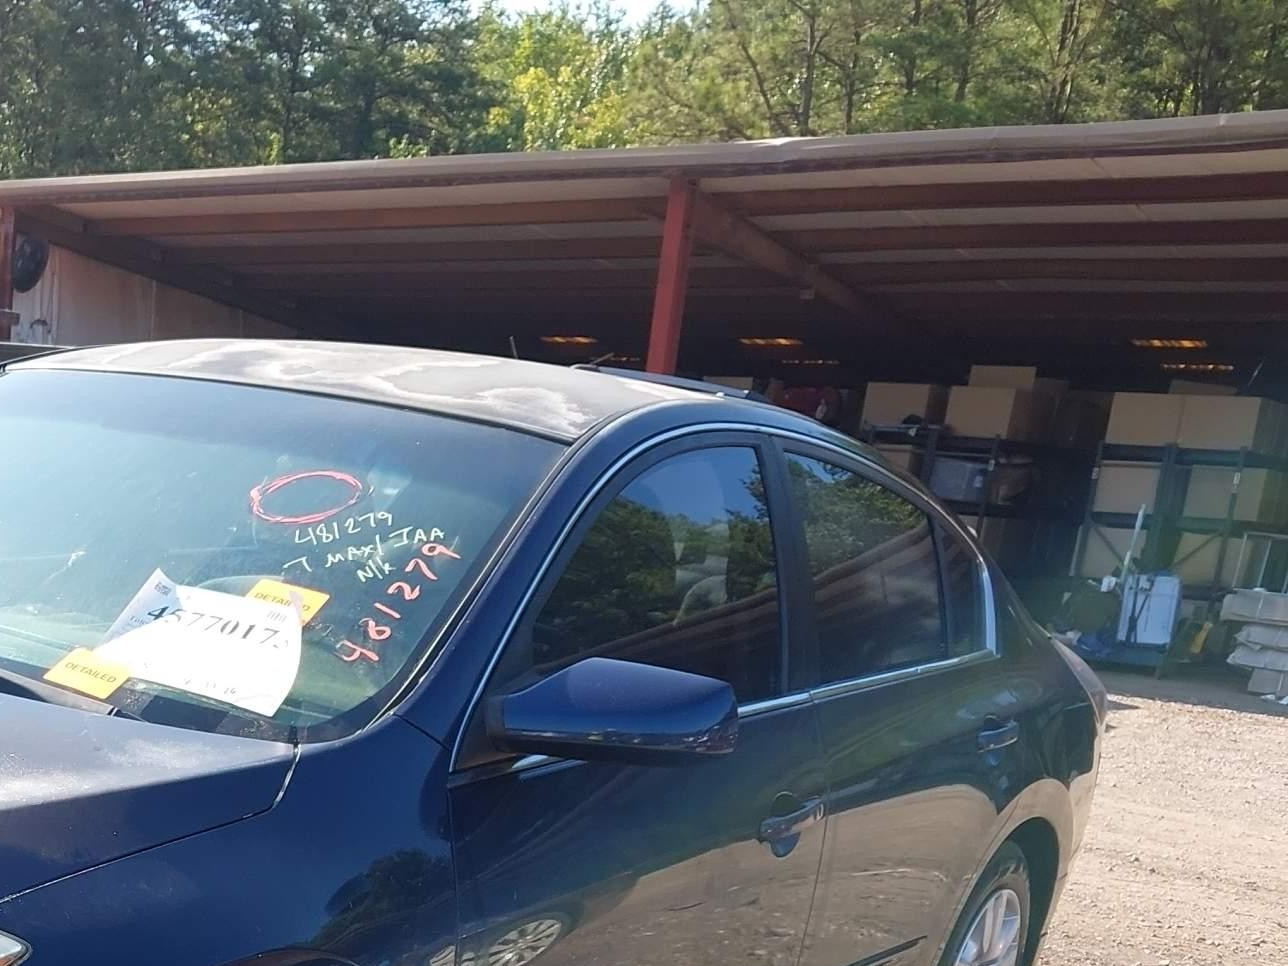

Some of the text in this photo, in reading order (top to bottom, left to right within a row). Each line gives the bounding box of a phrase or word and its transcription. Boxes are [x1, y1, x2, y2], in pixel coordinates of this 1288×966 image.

[295, 511, 393, 546] 481279
[336, 543, 462, 662] 481279
[64, 661, 117, 684] DETAILED
